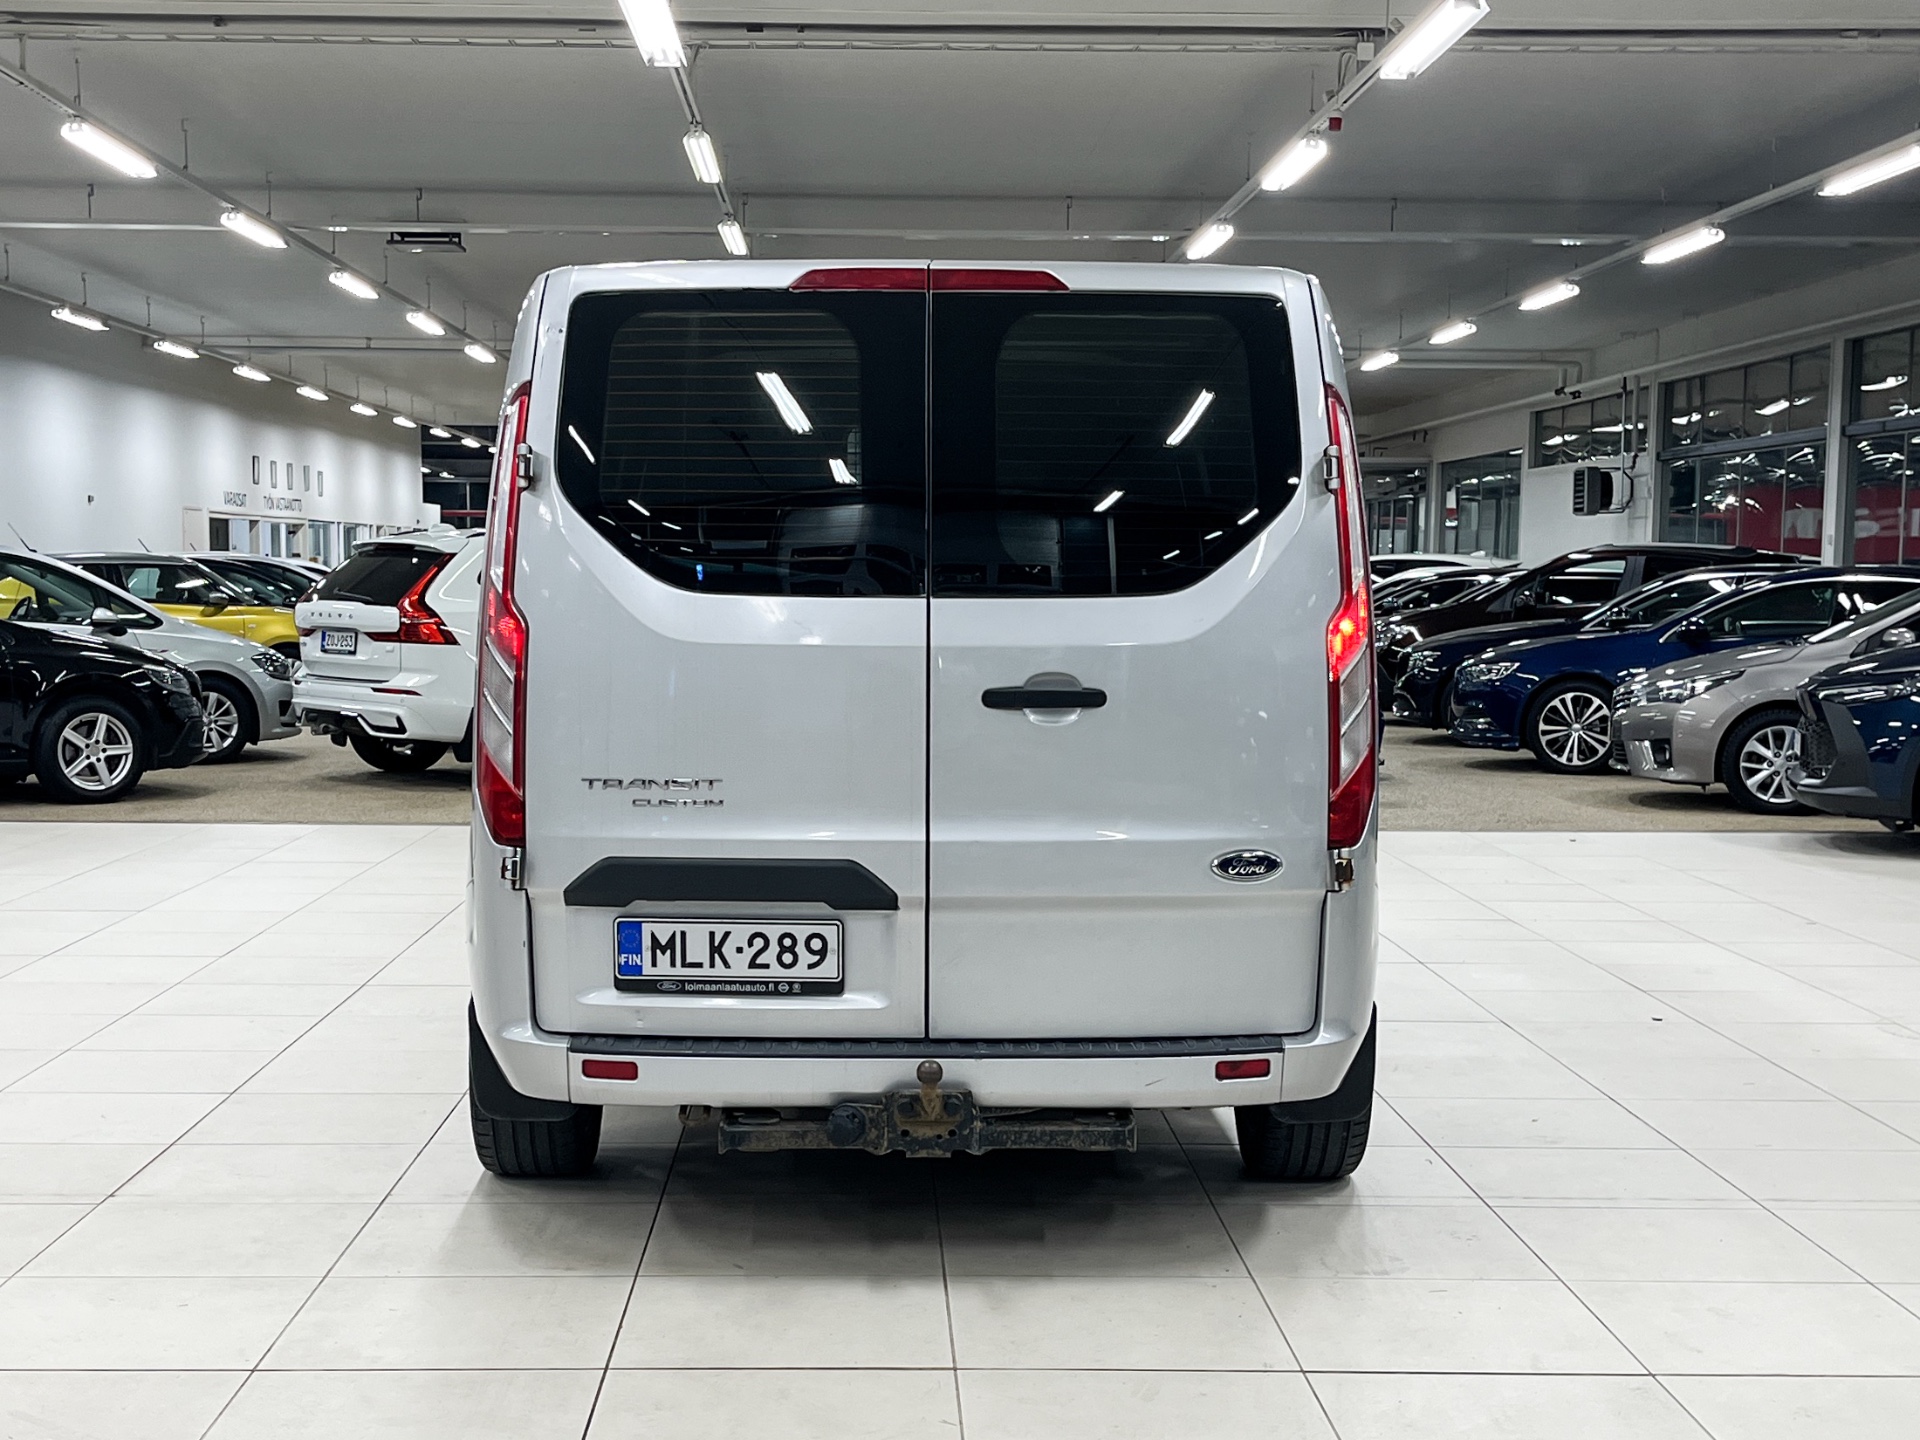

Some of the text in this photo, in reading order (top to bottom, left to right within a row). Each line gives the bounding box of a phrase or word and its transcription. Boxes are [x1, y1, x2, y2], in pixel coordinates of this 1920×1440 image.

[310, 611, 353, 620] VOLVO
[581, 778, 723, 790] TRANSIT
[632, 799, 724, 807] CUSTOM
[1228, 857, 1268, 874] Ford
[650, 930, 828, 970] MLK-289
[621, 954, 643, 965] FIN
[684, 982, 775, 992] loimaanlaatuauto.fi
